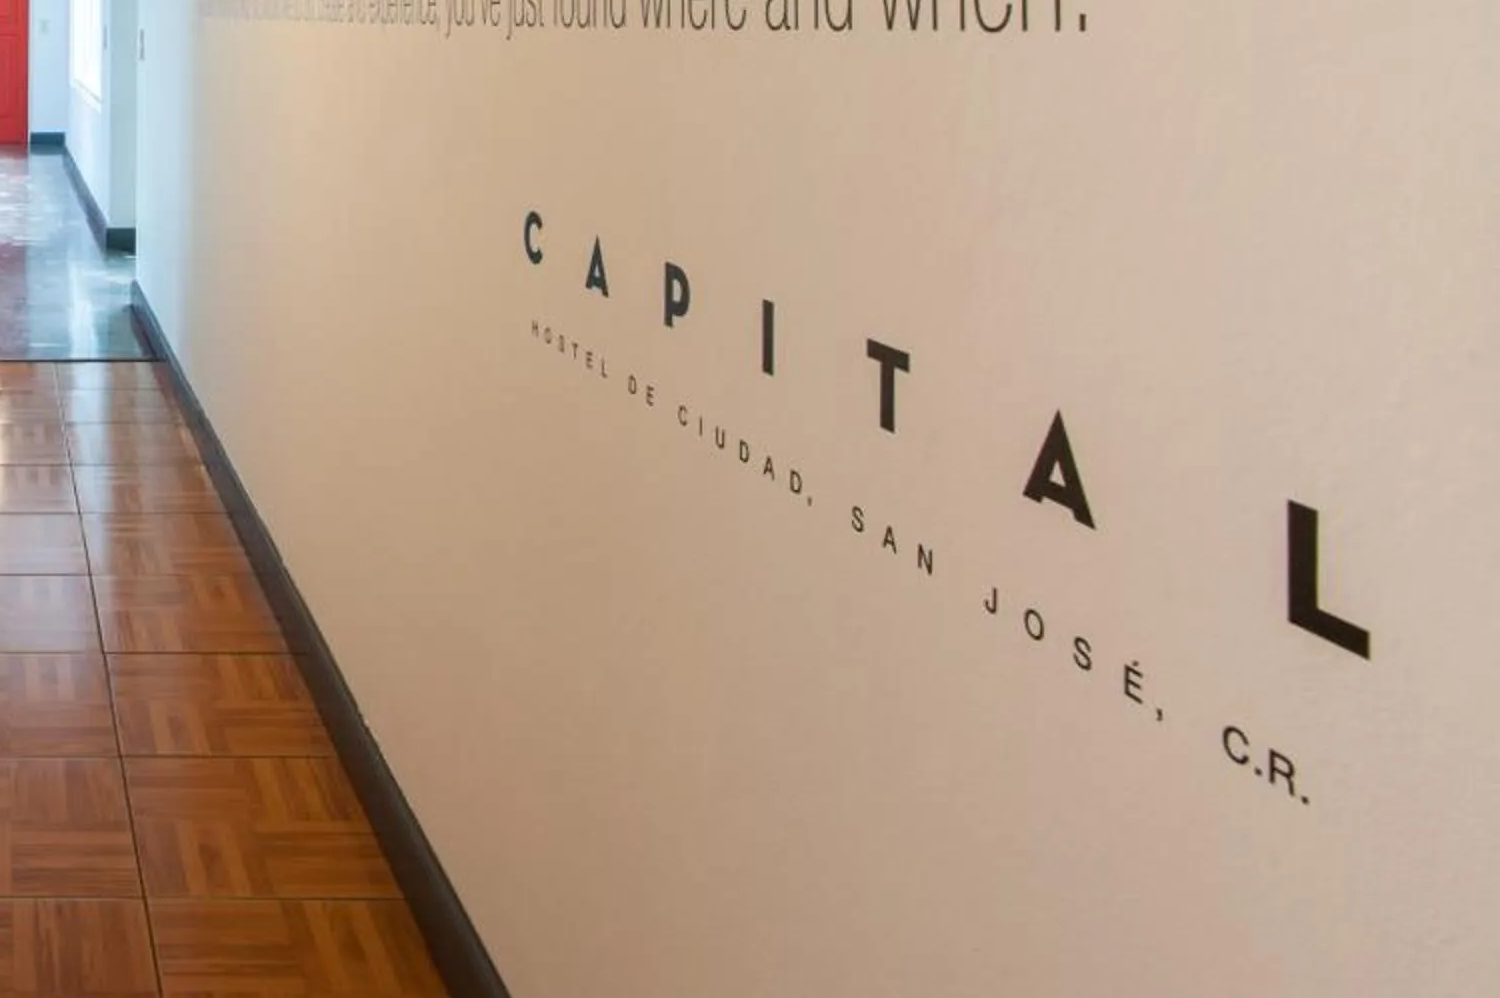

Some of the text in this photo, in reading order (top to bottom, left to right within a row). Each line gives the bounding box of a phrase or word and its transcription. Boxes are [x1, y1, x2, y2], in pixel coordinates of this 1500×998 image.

[524, 211, 1370, 660] CAPITAL
[531, 320, 1309, 804] HOSTEL DE CIUDAD, SAN JOSÉ, C.R.
